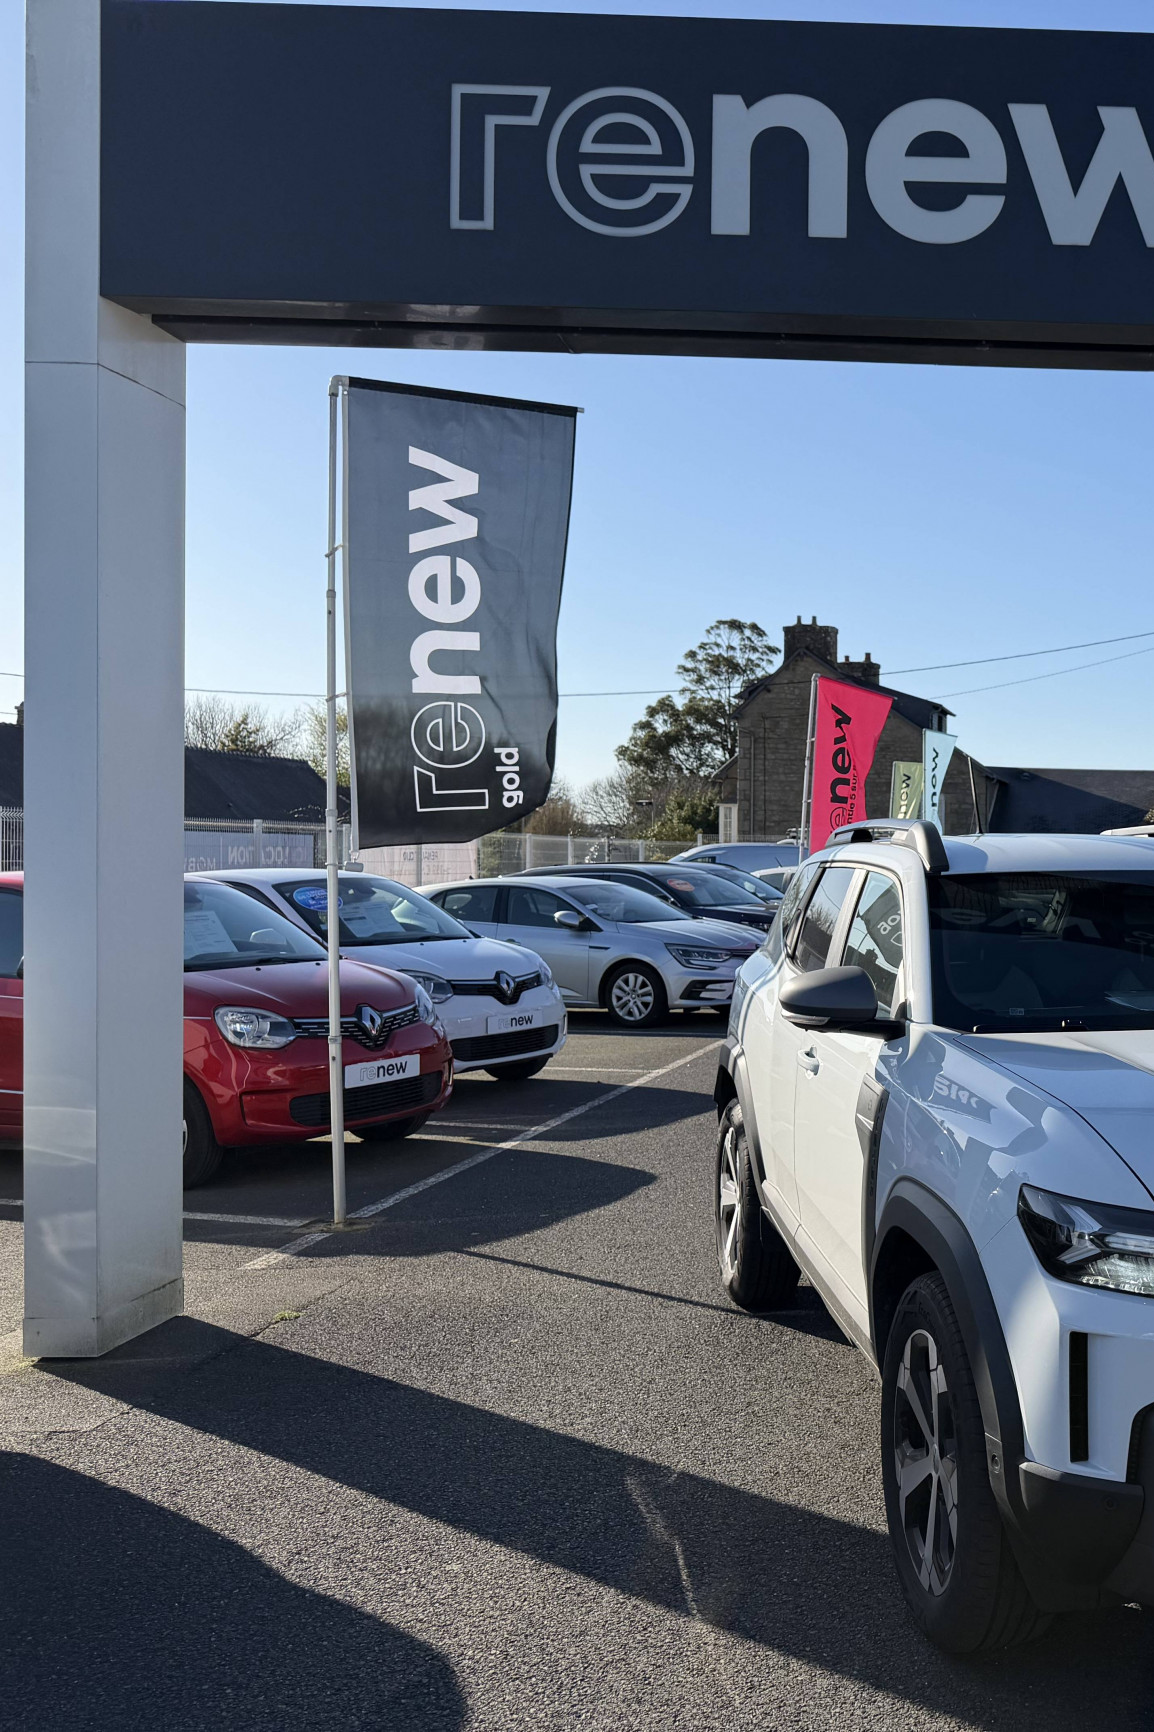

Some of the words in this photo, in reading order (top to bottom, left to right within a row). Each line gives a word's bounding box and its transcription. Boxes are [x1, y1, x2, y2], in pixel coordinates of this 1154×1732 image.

[408, 445, 489, 812] renew
[494, 747, 523, 808] gold
[830, 703, 852, 833] enew
[359, 1060, 408, 1082] renew
